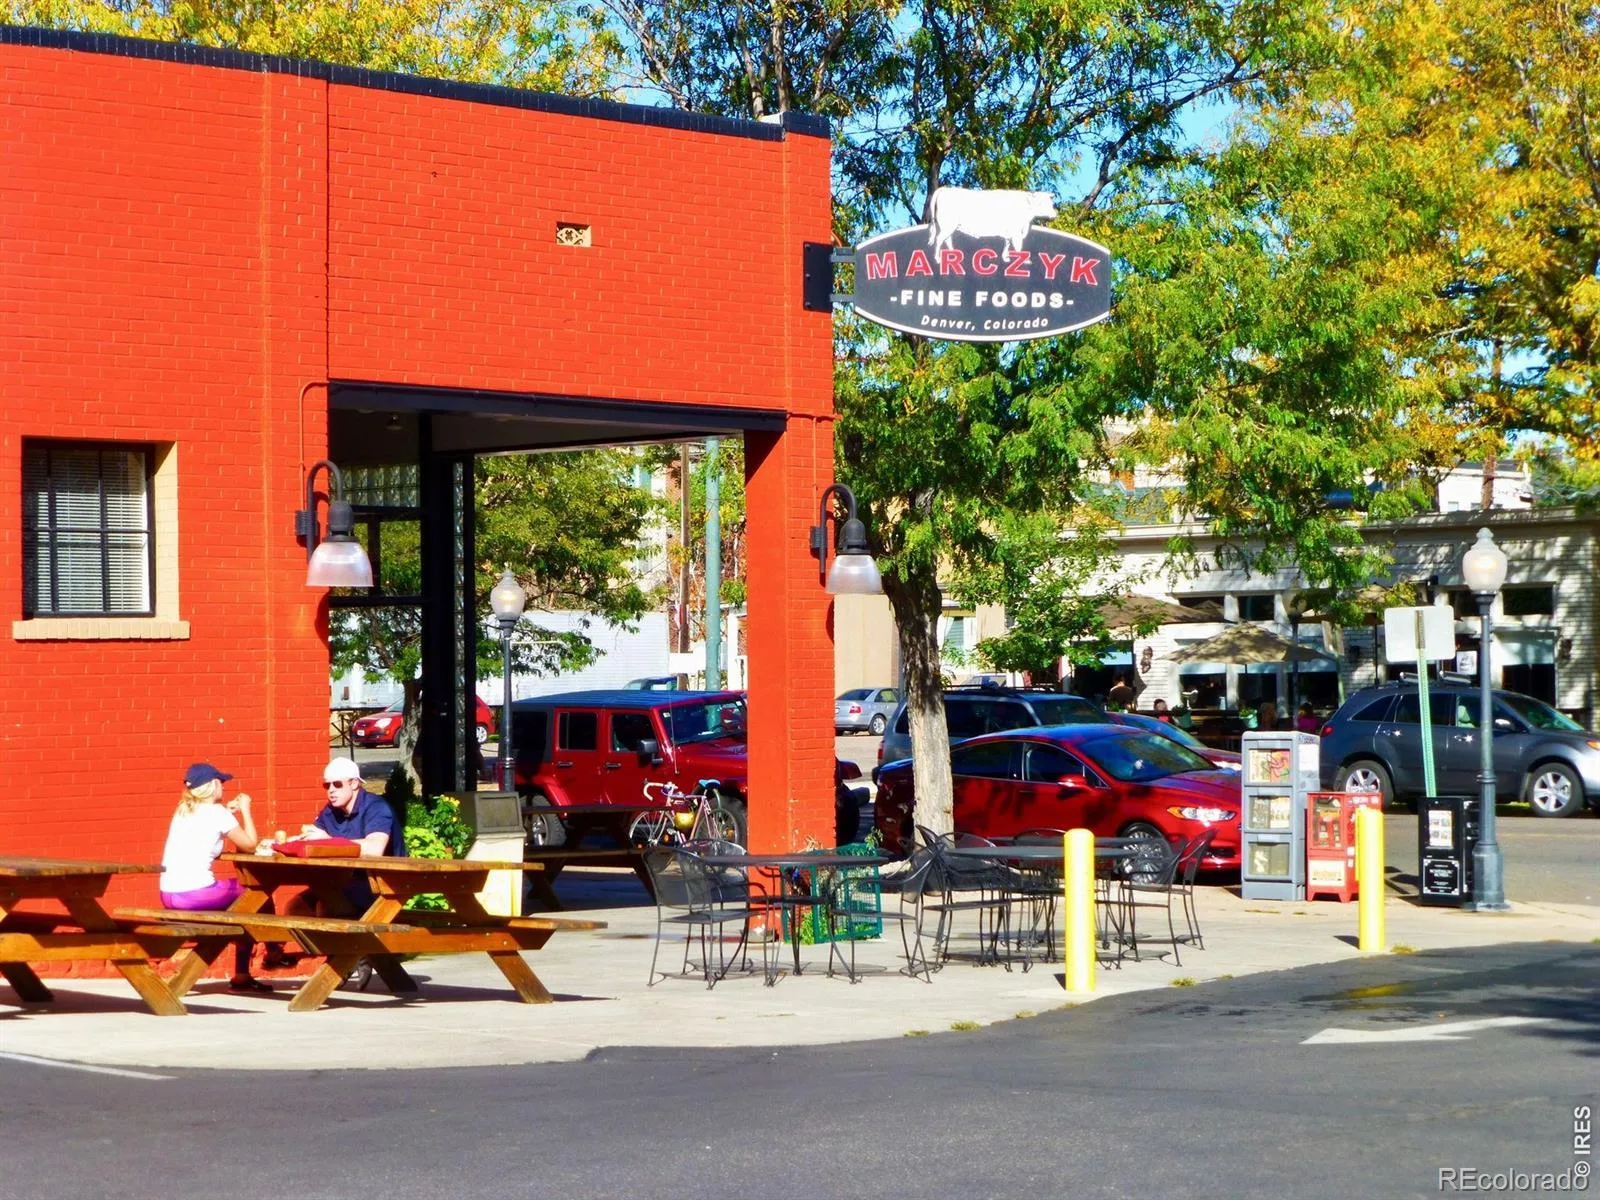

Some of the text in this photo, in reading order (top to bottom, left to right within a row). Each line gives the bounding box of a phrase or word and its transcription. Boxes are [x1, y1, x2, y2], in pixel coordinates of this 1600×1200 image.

[865, 248, 1101, 286] MARCZYK
[920, 315, 1049, 331] Denver, Colorado
